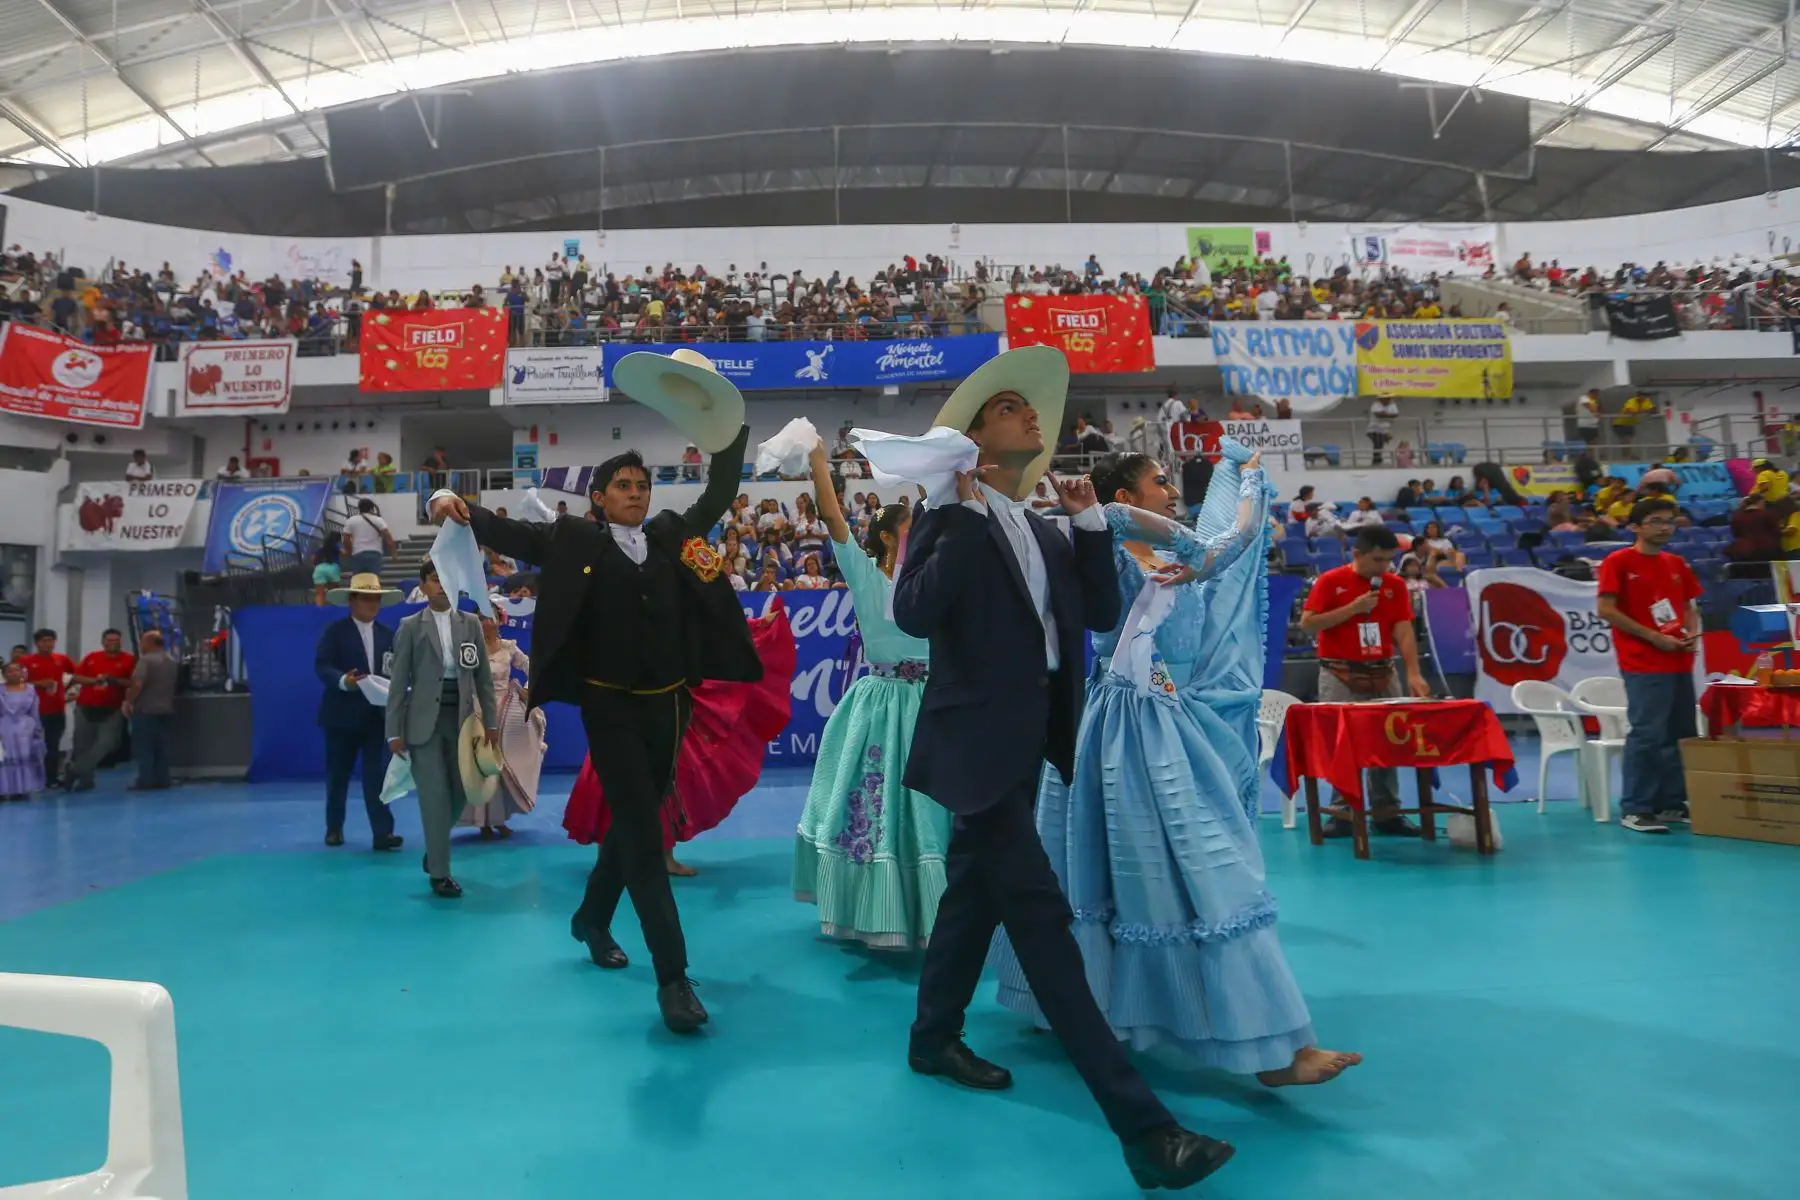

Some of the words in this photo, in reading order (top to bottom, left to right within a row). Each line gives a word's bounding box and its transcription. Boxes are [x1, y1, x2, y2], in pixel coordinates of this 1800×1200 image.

[1056, 314, 1100, 328] FIELD
[412, 329, 456, 345] FIELD
[1453, 323, 1506, 340] CULTURAL
[885, 342, 933, 356] Michelle
[1246, 326, 1334, 357] RITMO
[1337, 325, 1356, 355] Y
[224, 349, 286, 361] PRIMERO
[1392, 343, 1427, 359] SOMOS
[1428, 343, 1504, 359] INDEPENDIENTES
[875, 351, 944, 372] Pimentel
[245, 364, 262, 376] LO
[222, 379, 282, 393] NUESTRO
[1227, 422, 1270, 436] BAILA
[128, 482, 196, 498] PRIMERO
[148, 503, 168, 519] LO
